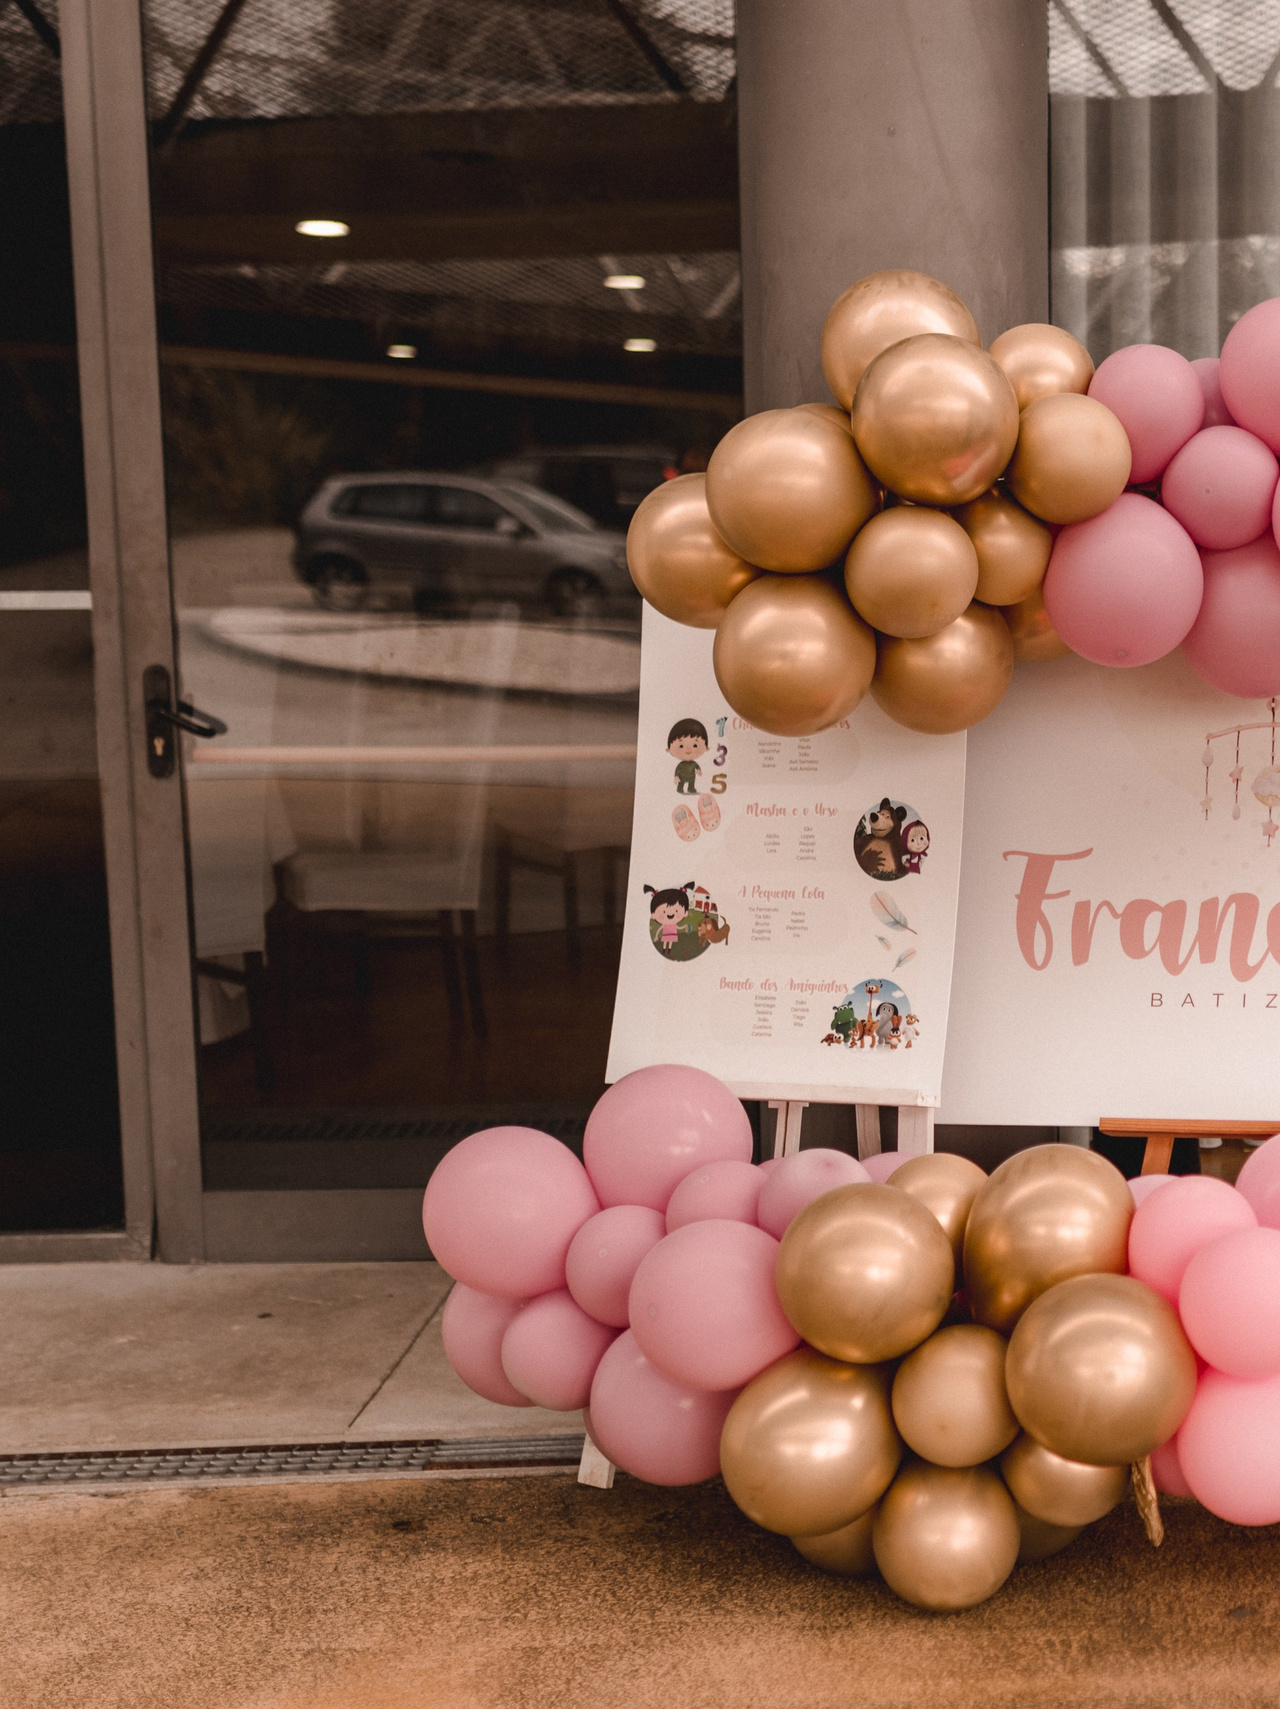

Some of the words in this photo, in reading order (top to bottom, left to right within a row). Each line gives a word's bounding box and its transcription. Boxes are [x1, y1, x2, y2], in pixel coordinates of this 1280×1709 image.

[710, 773, 728, 794] 5
[745, 802, 787, 818] Masha
[792, 807, 798, 816] e
[802, 806, 809, 816] o
[814, 802, 838, 817] Urso
[737, 885, 747, 898] A
[751, 885, 796, 902] Pequena
[801, 885, 826, 900] Lola
[719, 976, 755, 991] Bando
[760, 978, 778, 993] dos
[784, 978, 849, 996] Amiguinhos
